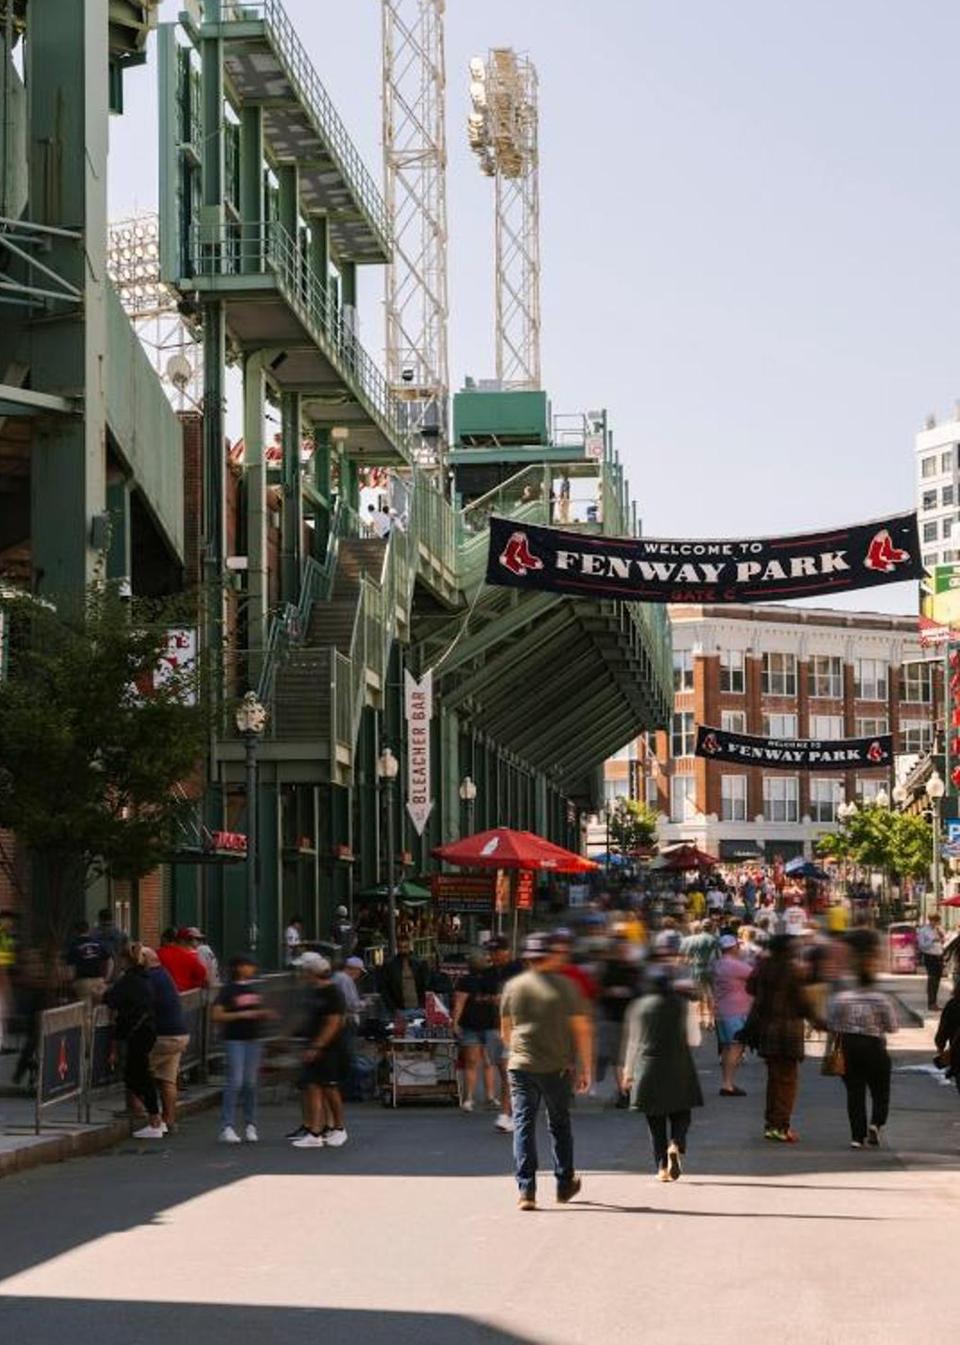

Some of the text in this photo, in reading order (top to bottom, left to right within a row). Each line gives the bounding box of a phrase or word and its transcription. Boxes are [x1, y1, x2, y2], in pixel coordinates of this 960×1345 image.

[644, 543, 763, 556] WELCOME TO
[555, 551, 851, 583] FENWAY PARK
[671, 587, 717, 601] GATE
[411, 690, 427, 721] BAR
[727, 743, 860, 762] FENWAY PARK
[412, 726, 427, 805] BLEACHER
